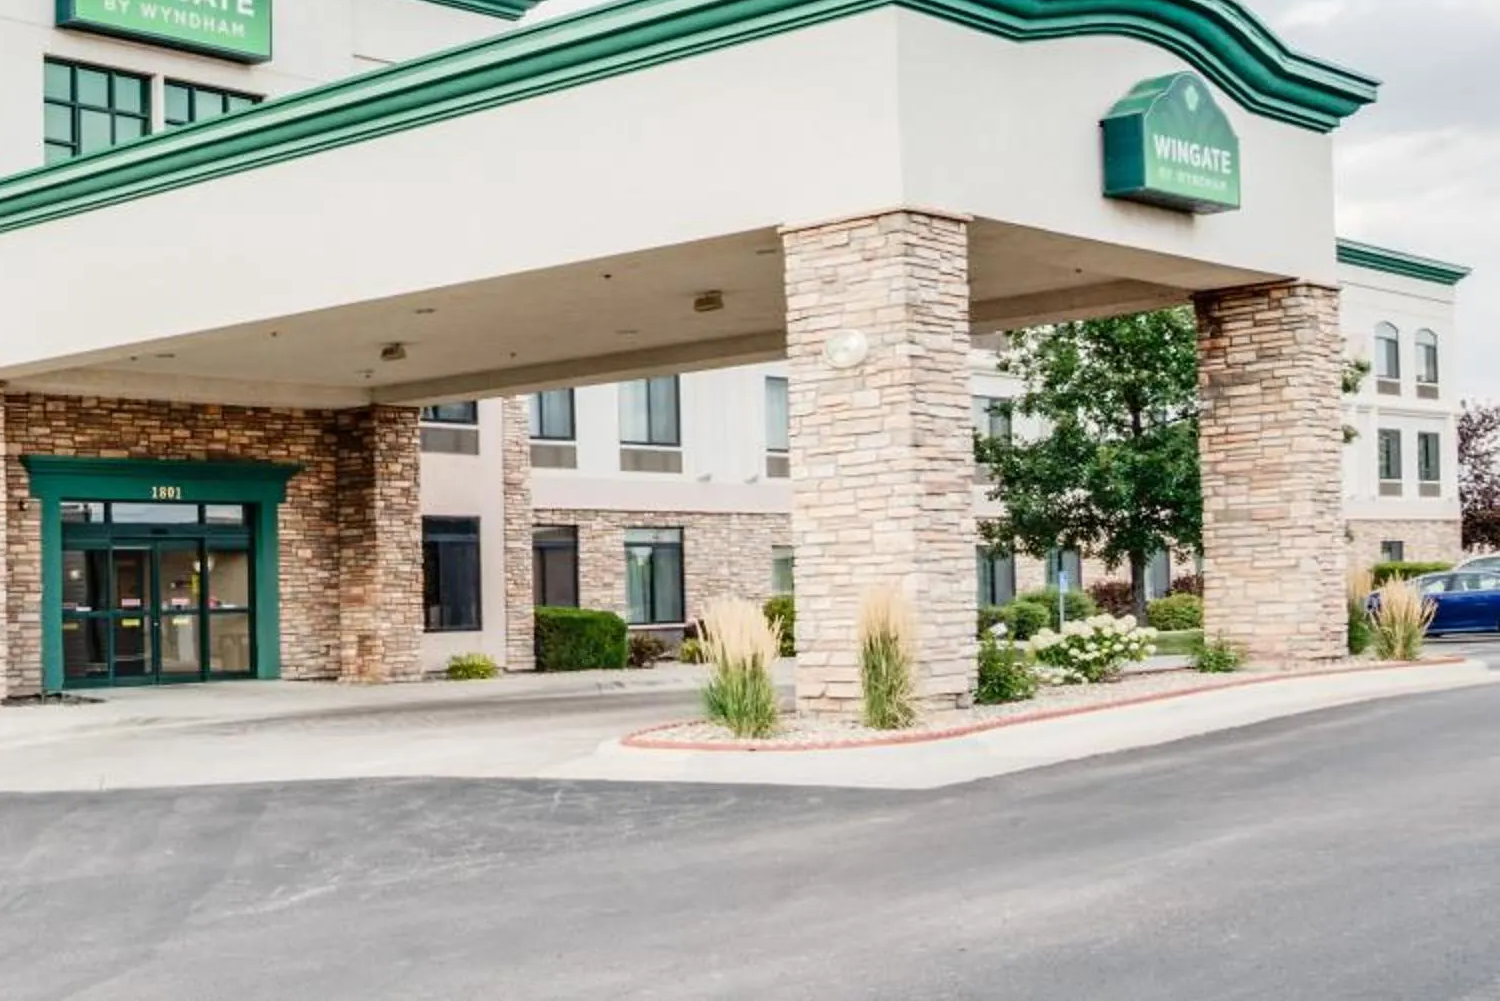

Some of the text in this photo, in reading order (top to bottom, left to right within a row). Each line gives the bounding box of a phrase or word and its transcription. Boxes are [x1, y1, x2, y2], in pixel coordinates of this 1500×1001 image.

[140, 2, 245, 37] WYNDHAM
[1153, 134, 1232, 174] WINGATE
[151, 486, 181, 499] 1801
